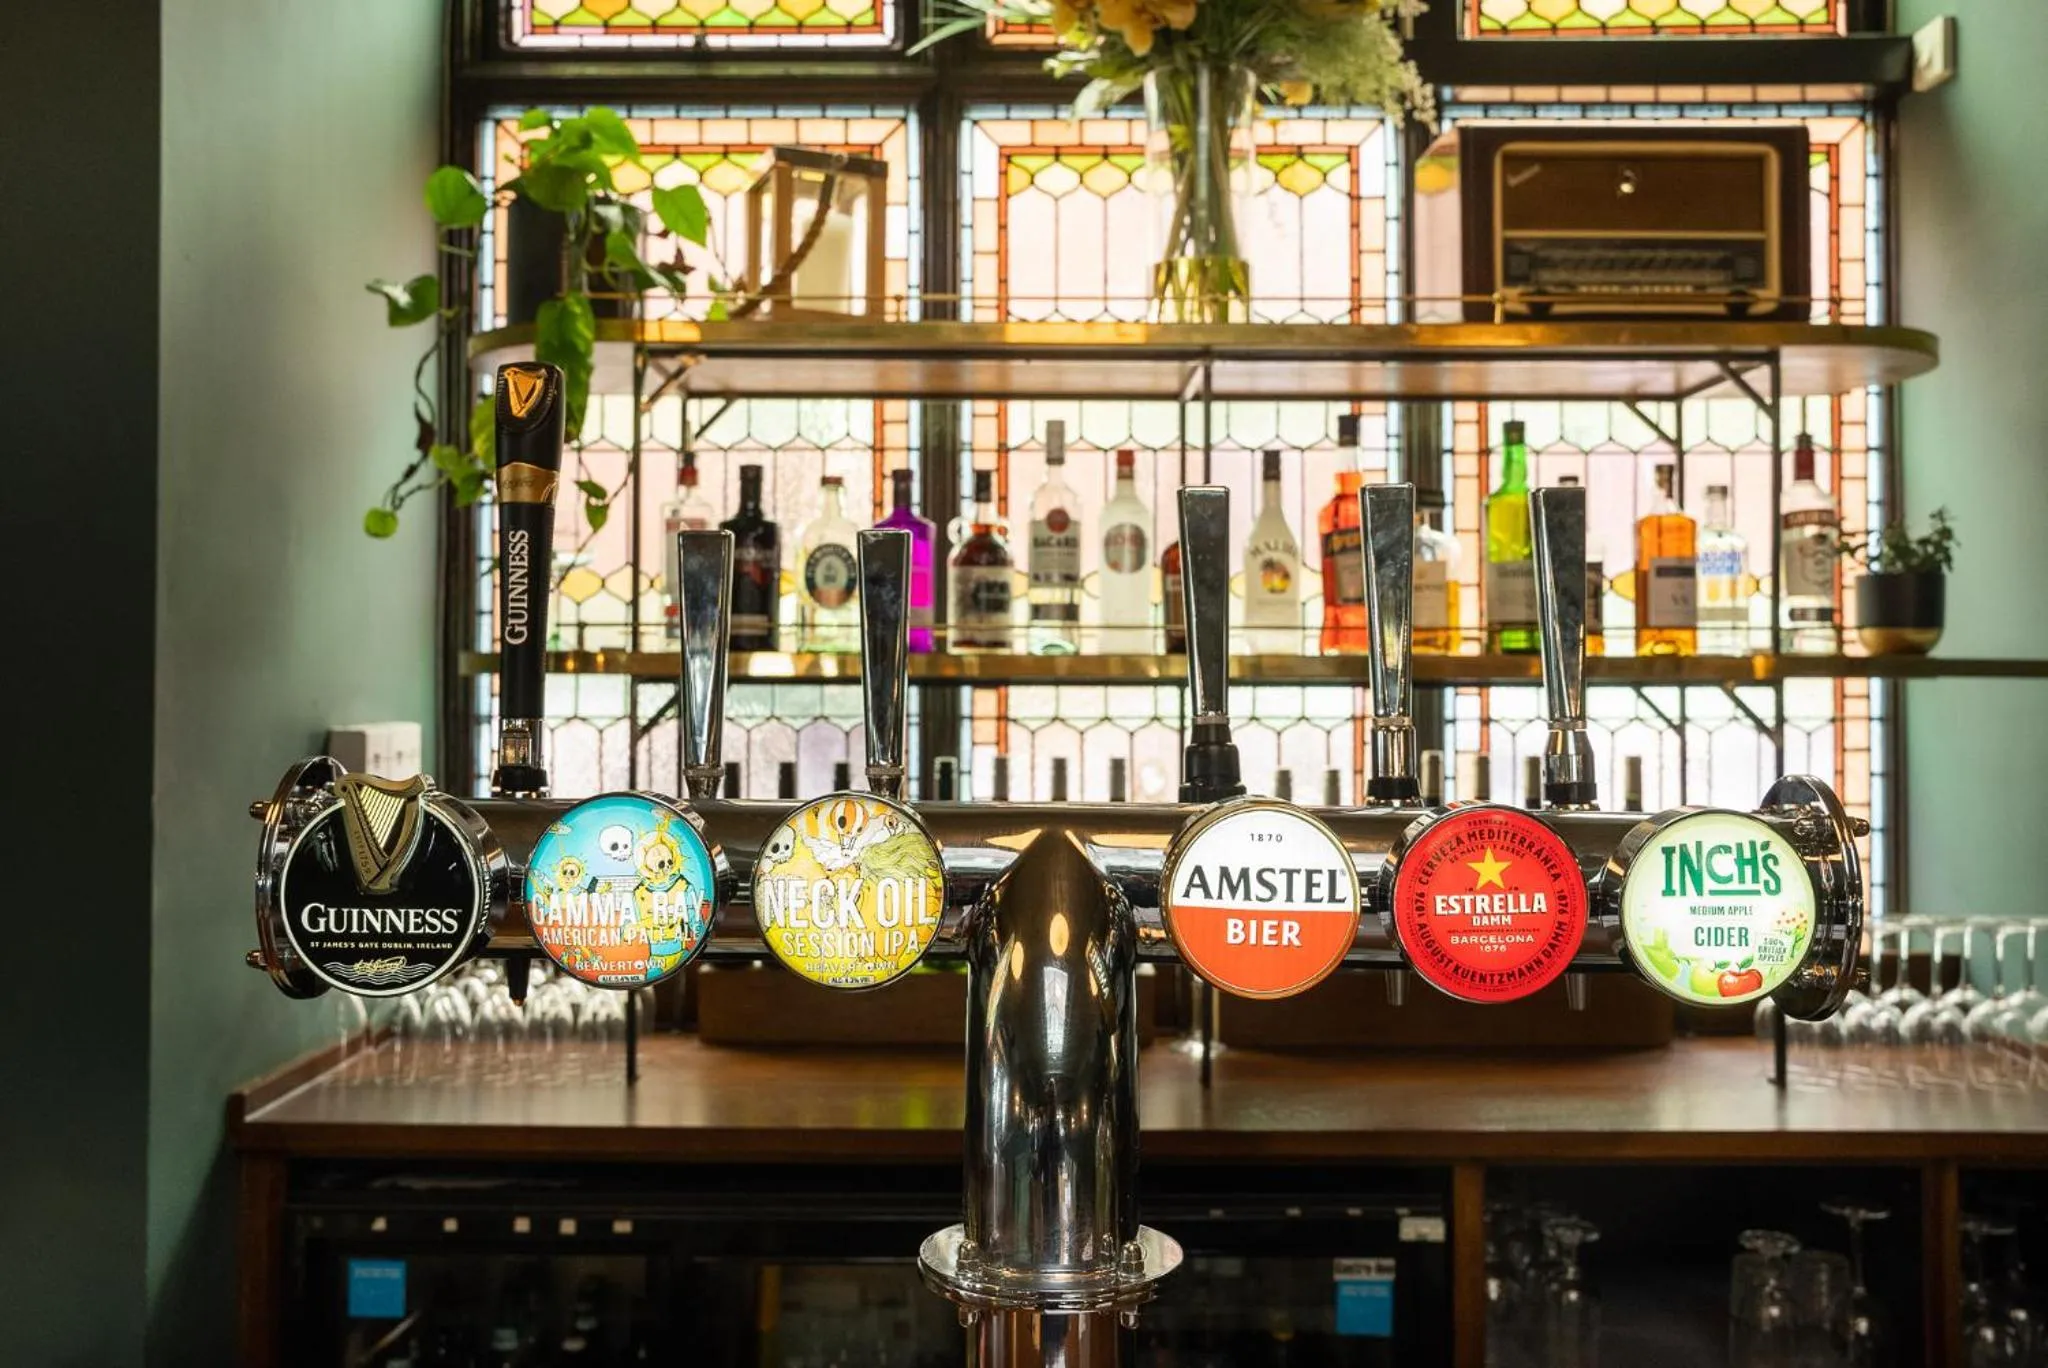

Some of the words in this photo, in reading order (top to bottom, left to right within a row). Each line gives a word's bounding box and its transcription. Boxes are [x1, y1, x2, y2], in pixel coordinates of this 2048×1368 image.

[505, 529, 529, 645] GUINNESS
[1250, 833, 1283, 843] 1870
[1418, 836, 1466, 885] CERVEZA
[1182, 865, 1347, 903] AMSTEL
[531, 891, 639, 926] GAMMA
[653, 890, 705, 925] RAY
[763, 878, 867, 929] NECK
[877, 877, 937, 928] OIL
[1434, 892, 1548, 916] ESTRELLA
[1690, 905, 1725, 916] MEDIUM
[1728, 905, 1753, 916] APPLE
[301, 902, 460, 935] GUINNESS
[1472, 915, 1513, 927] DAMM
[310, 941, 320, 949] ST
[358, 941, 380, 949] GATE
[417, 941, 453, 949] IRELAND
[542, 926, 622, 947] AMERICAN
[628, 926, 668, 945] PALE
[675, 924, 703, 942] ALE
[782, 930, 876, 958] SESSION
[884, 929, 921, 956] IPA
[1226, 918, 1303, 947] BIER
[1450, 934, 1535, 945] BARCELONA
[1693, 926, 1750, 948] CIDER
[1417, 922, 1454, 967] AUGUST
[1453, 957, 1546, 985] KUENTZMANN
[1542, 920, 1569, 958] DAMM
[1479, 944, 1508, 953] 1876
